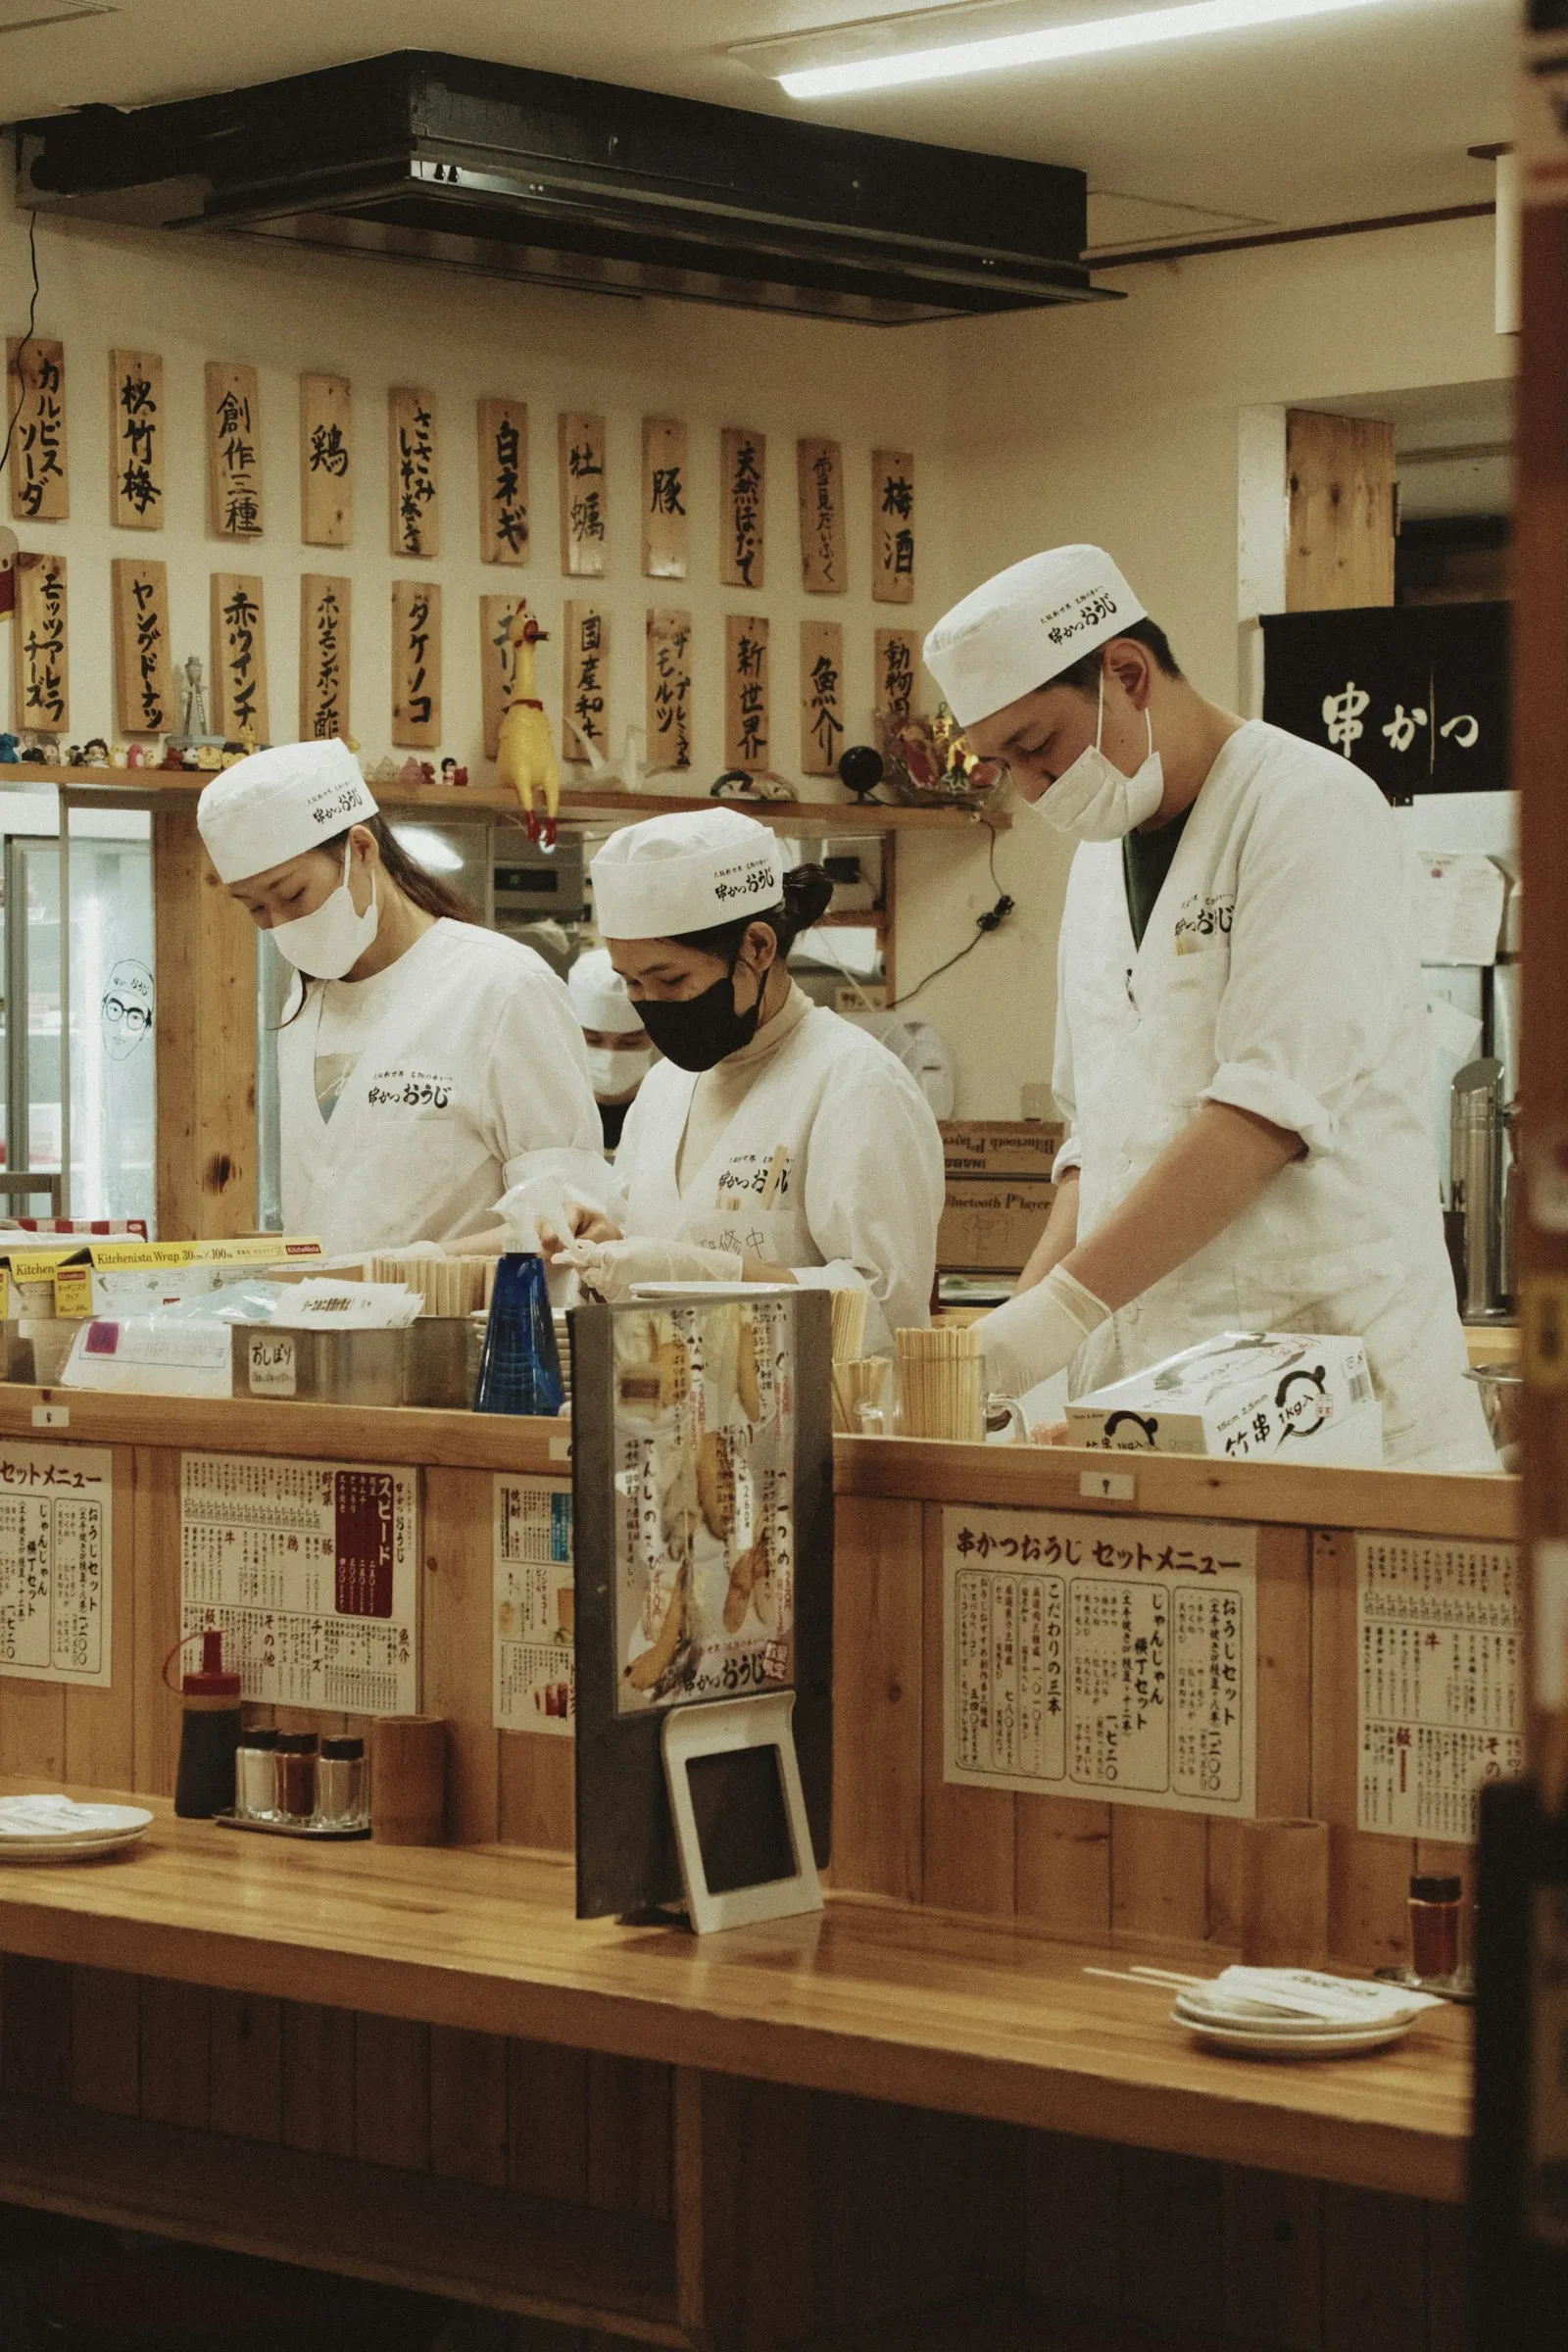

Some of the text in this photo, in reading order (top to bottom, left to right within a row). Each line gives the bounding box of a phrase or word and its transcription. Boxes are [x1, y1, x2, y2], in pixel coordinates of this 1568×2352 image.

[38, 360, 63, 476] カルピス
[217, 392, 263, 533] 創作三種
[310, 424, 349, 477] 鶏
[413, 408, 435, 503] ささみ
[20, 423, 49, 516] ソーダ
[493, 419, 529, 555] 白ネギ
[569, 443, 605, 542] 牡蠣
[651, 467, 687, 516] 豚
[732, 447, 761, 586] 天然ほたて
[882, 476, 914, 574] 梅酒
[133, 579, 164, 730] ヤングドーナツ
[223, 592, 259, 731] 赤ウインナ
[409, 603, 433, 723] タケノコ
[1048, 592, 1117, 646] 串かつおうじ
[24, 629, 44, 709] チーズ
[313, 594, 342, 741] ホルモンポン酢
[655, 648, 677, 733] モルツ
[737, 635, 768, 761] 新世界
[810, 655, 844, 767] 魚介
[1322, 681, 1479, 759] 串かつ
[714, 865, 774, 902] 串かつおうじ
[368, 1083, 453, 1109] 串かつおうじ
[97, 1250, 152, 1265] Kitchenista
[154, 1250, 179, 1263] Wrap
[2, 1460, 103, 1489] セットメニュー
[377, 1476, 392, 1567] スピード
[87, 1507, 99, 1613] おうじセット
[956, 1526, 1243, 1576] 串かつおうじ セットメニュー
[264, 1613, 275, 1668] その他
[311, 1619, 322, 1673] チーズ
[398, 1627, 411, 1665] 魚介
[685, 1650, 768, 1696] 串かつおうじ
[1047, 1583, 1062, 1717] こだわりの三本
[1152, 1592, 1166, 1706] じゃんじゃん
[1222, 1597, 1237, 1728] おうじセット
